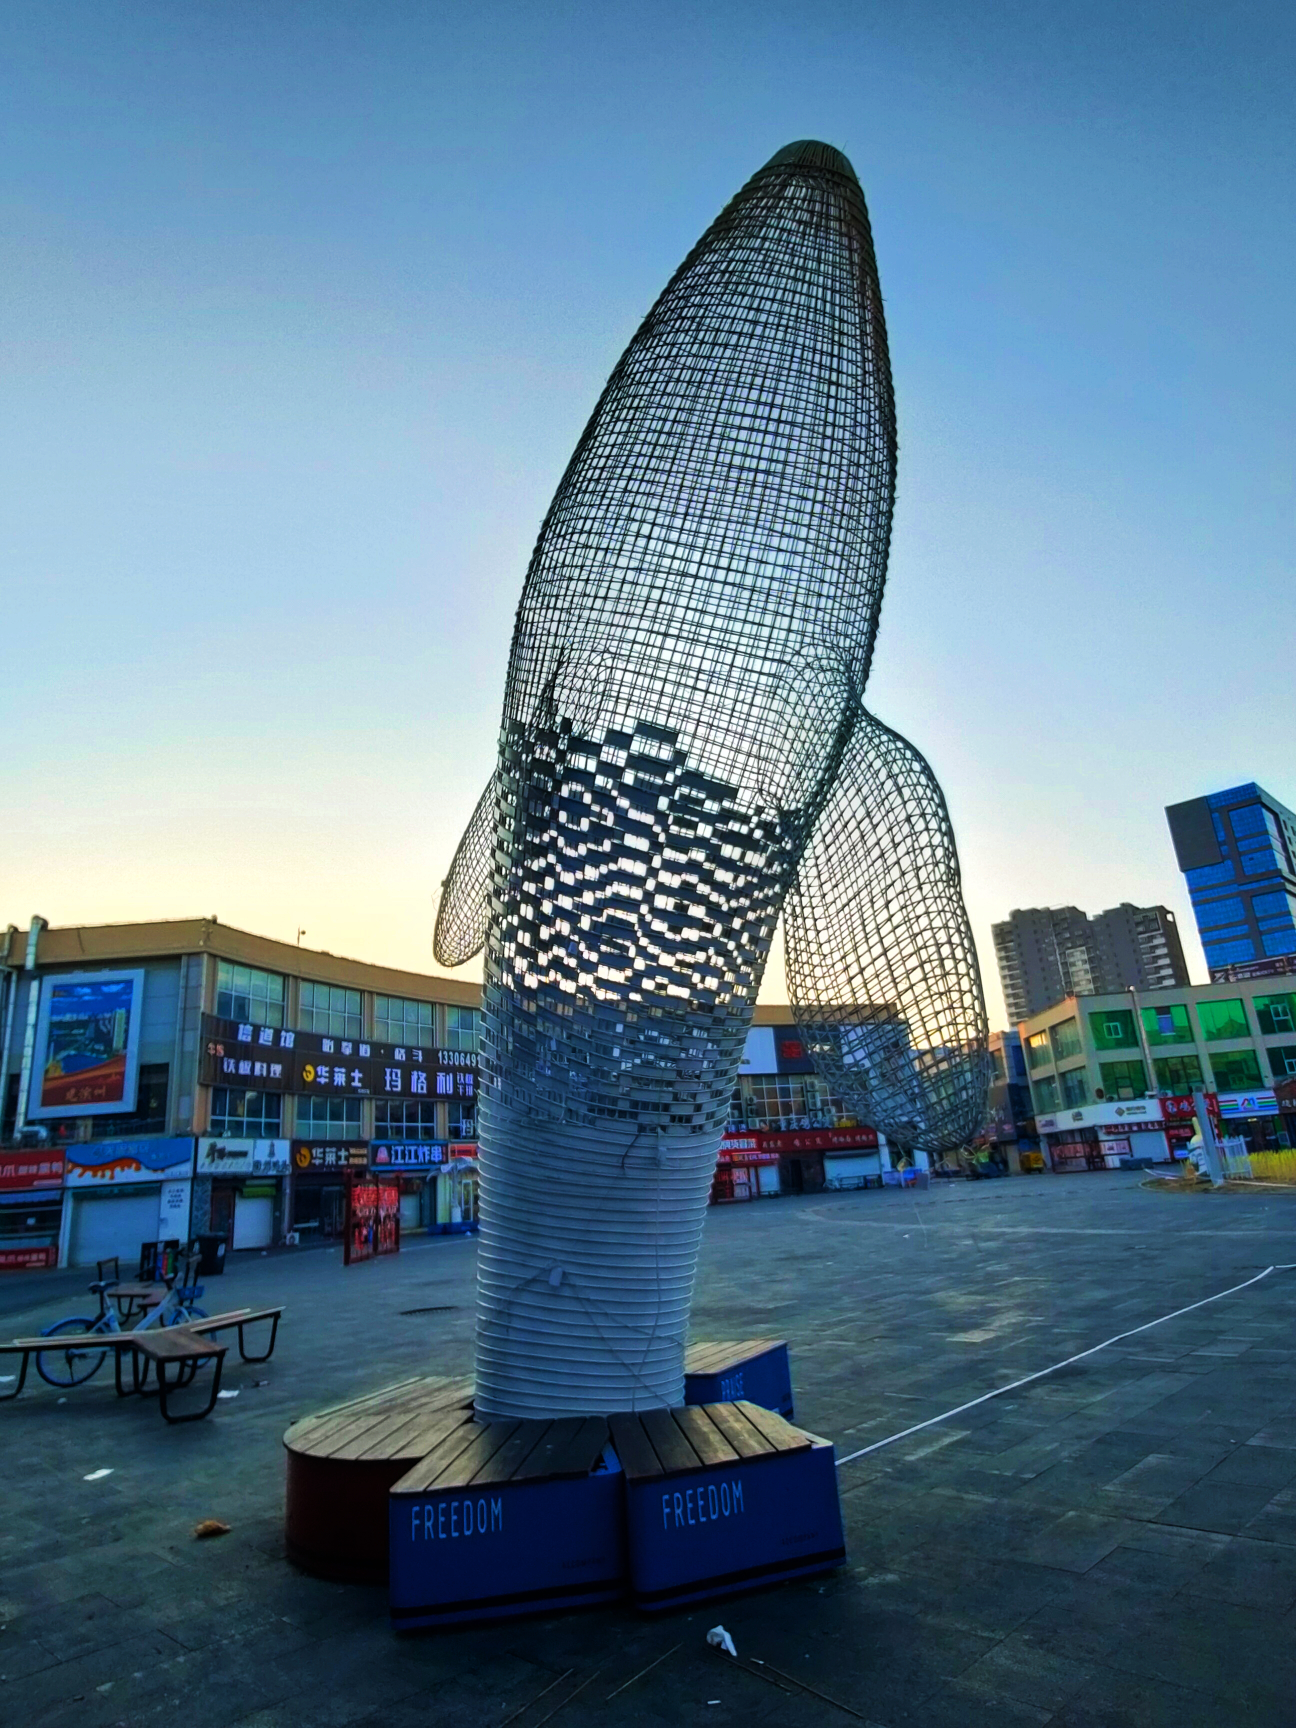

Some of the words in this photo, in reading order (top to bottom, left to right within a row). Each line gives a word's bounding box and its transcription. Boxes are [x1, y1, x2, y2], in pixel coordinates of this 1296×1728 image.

[223, 1057, 282, 1079] 铁板料理
[316, 1065, 363, 1088] 华莱士
[385, 1067, 453, 1095] 玛格利
[311, 1147, 348, 1165] 华莱士
[391, 1145, 443, 1164] 江江炸串
[662, 1480, 744, 1530] FREEDOM
[412, 1497, 502, 1542] FREEDOM
